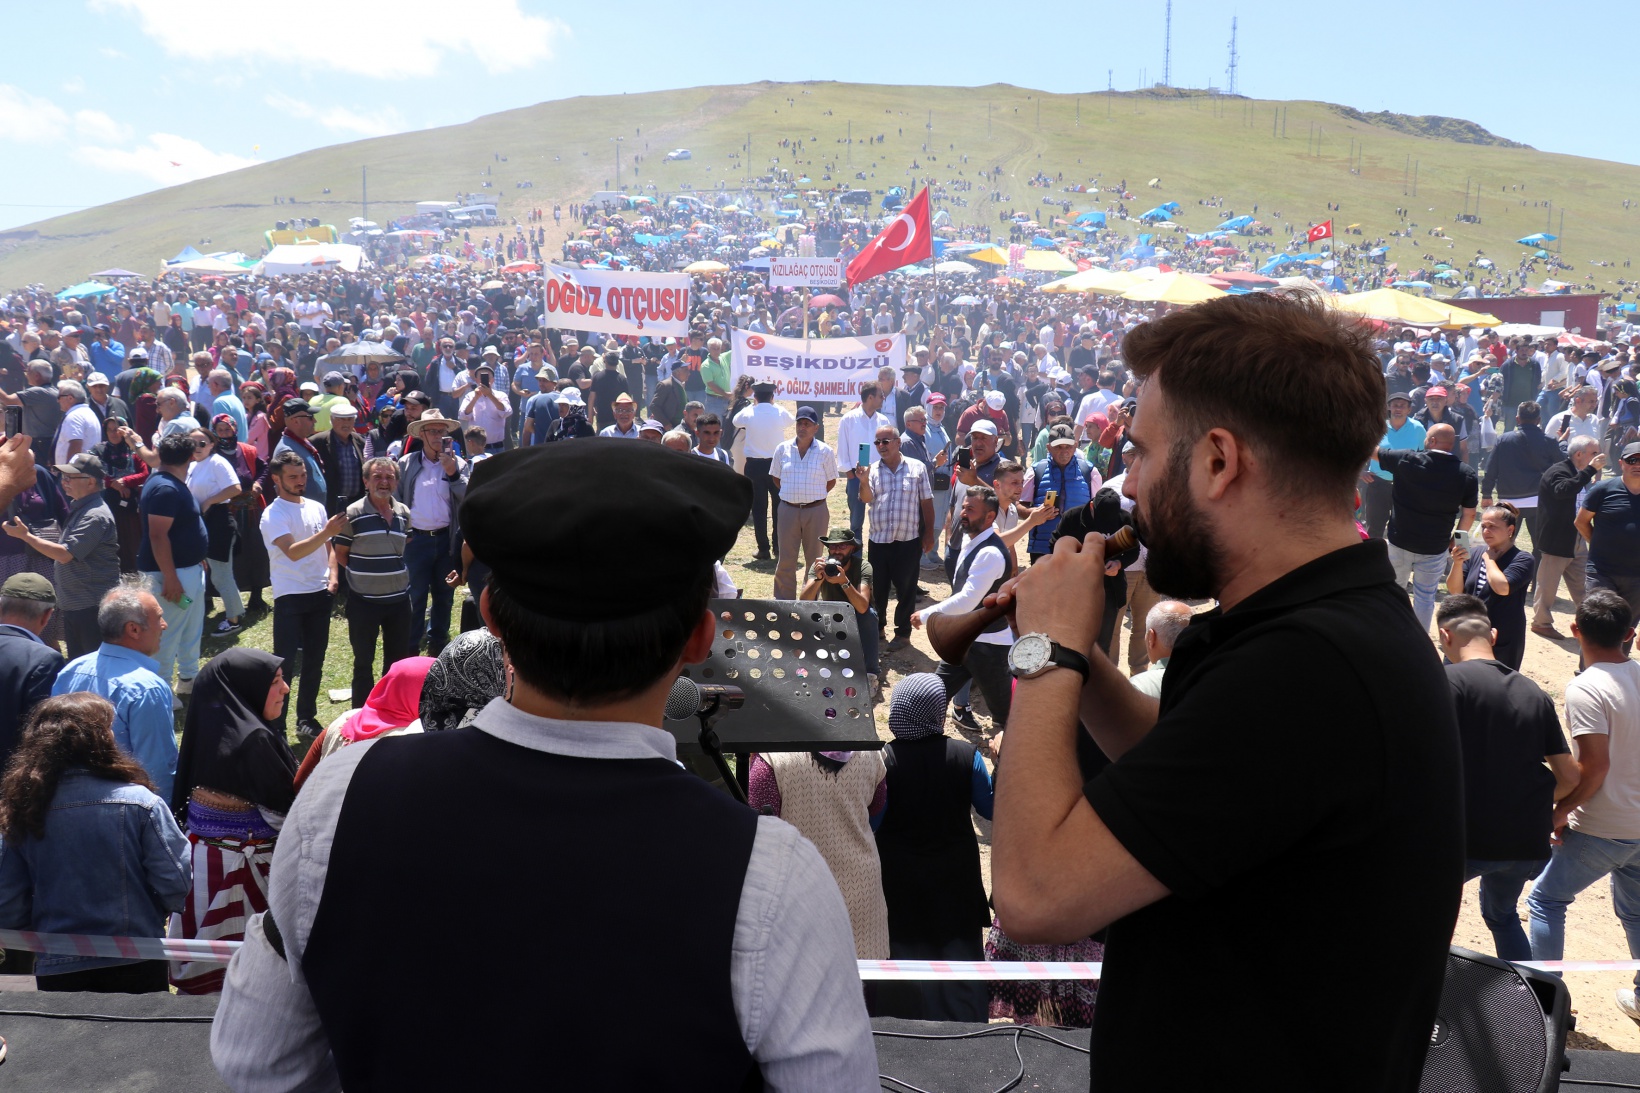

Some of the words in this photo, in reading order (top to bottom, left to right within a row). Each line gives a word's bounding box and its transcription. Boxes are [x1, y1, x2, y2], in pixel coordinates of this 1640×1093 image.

[772, 263, 808, 279] KIZILAĞAÇ
[809, 264, 838, 279] OTÇUSU
[546, 272, 603, 317] OĞUZ
[606, 286, 689, 330] OTÇUSU
[746, 354, 890, 371] BEŞİKDÜZÜ
[813, 379, 856, 398] ŞAHMELİK
